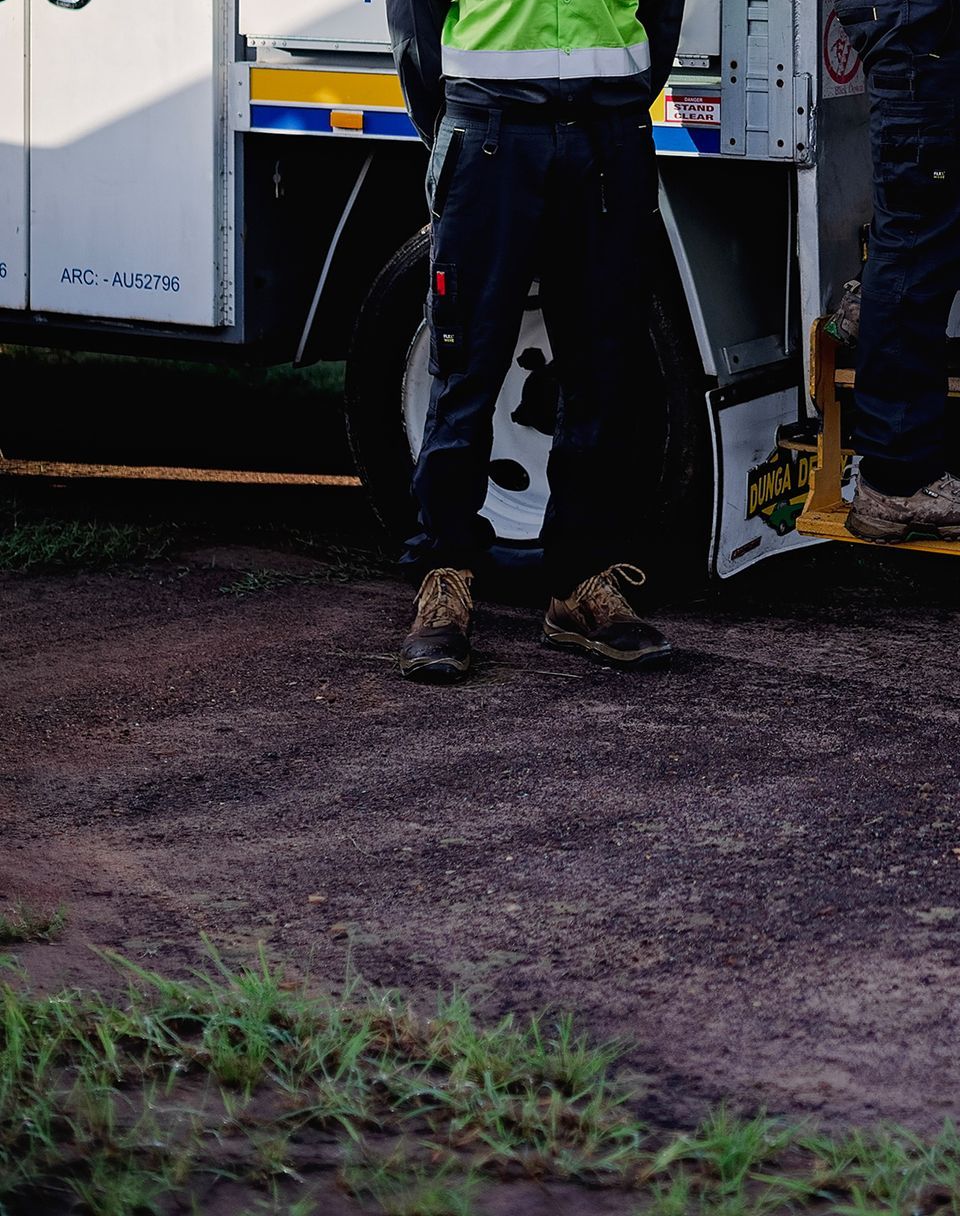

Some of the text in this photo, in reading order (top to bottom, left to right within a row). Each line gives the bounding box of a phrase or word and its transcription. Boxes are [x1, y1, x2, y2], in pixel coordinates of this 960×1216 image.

[674, 104, 715, 112] STAND
[674, 113, 714, 121] CLEAR
[61, 268, 98, 286] ARC:
[112, 271, 180, 292] AU52796
[749, 463, 791, 514] DUNGA
